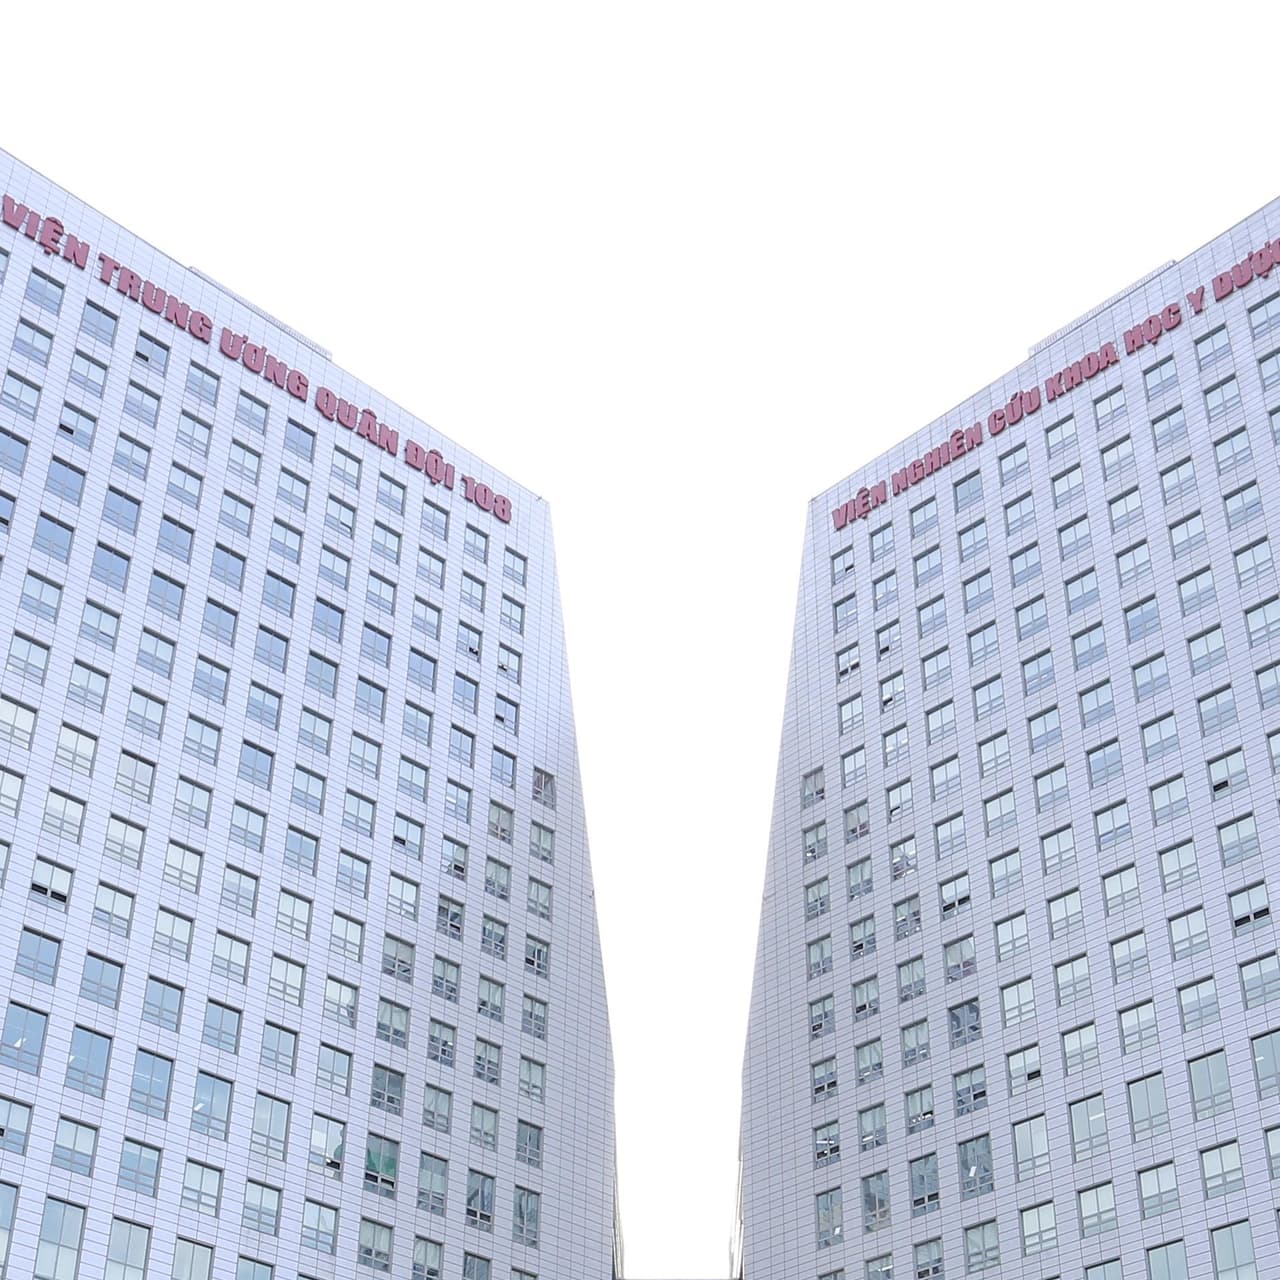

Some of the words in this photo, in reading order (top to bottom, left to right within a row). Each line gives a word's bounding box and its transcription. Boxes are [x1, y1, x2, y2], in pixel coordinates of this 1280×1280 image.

[3, 195, 90, 268] VIỆN
[99, 253, 213, 343] TRUNG
[220, 328, 308, 402] ƯƠNG
[316, 387, 400, 456] QUÂN
[404, 440, 455, 489] ĐỘI
[461, 476, 512, 524] 108
[831, 479, 888, 531] VIỆN
[891, 422, 983, 496] NGHIÊN
[987, 385, 1042, 436] CỨU
[1045, 341, 1119, 402] KHOA
[1123, 303, 1181, 355] HỌC
[1186, 286, 1207, 315] Y
